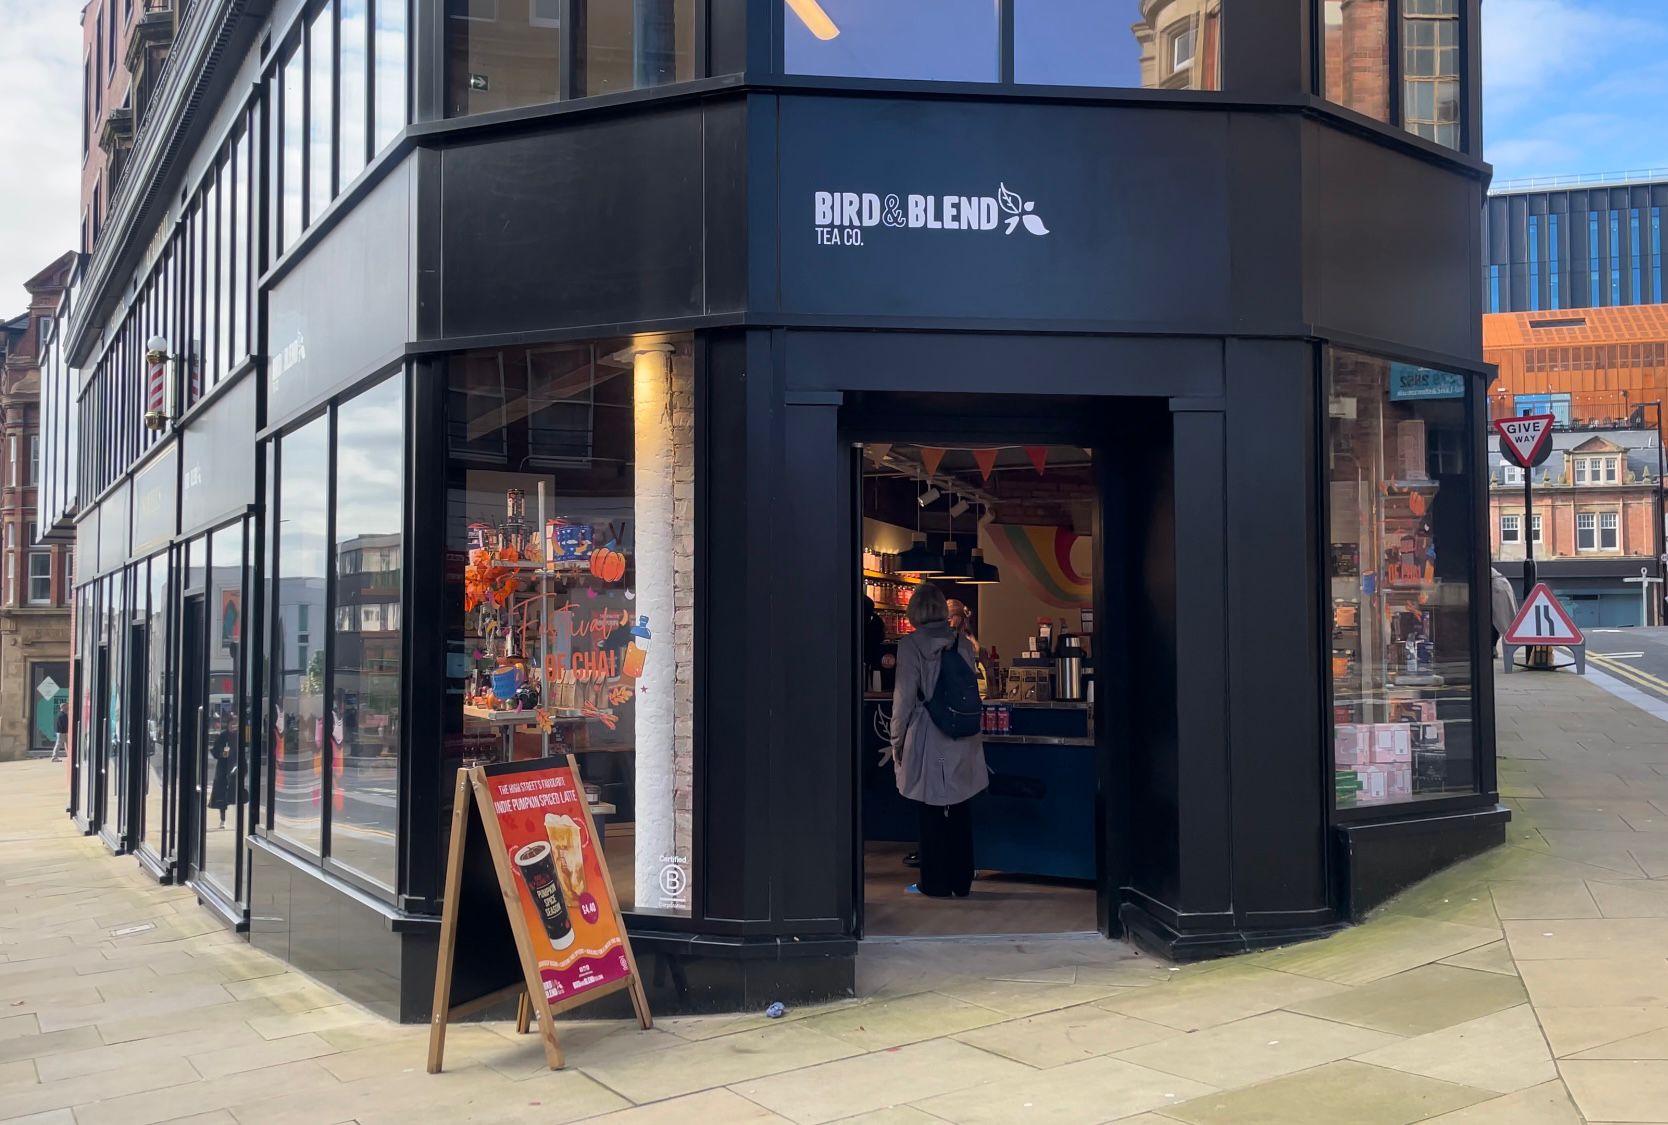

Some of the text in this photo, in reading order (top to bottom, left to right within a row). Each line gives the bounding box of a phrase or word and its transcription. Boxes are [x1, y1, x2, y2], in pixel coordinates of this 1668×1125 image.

[815, 227, 864, 246] TEA CO.
[1507, 422, 1541, 434] GIVE
[1514, 435, 1536, 443] WAY
[544, 649, 616, 683] OF CHAI
[498, 784, 509, 795] THE
[494, 789, 578, 814] INDIE PUMPKIN SPICED LATTE
[581, 902, 597, 915] £4.40
